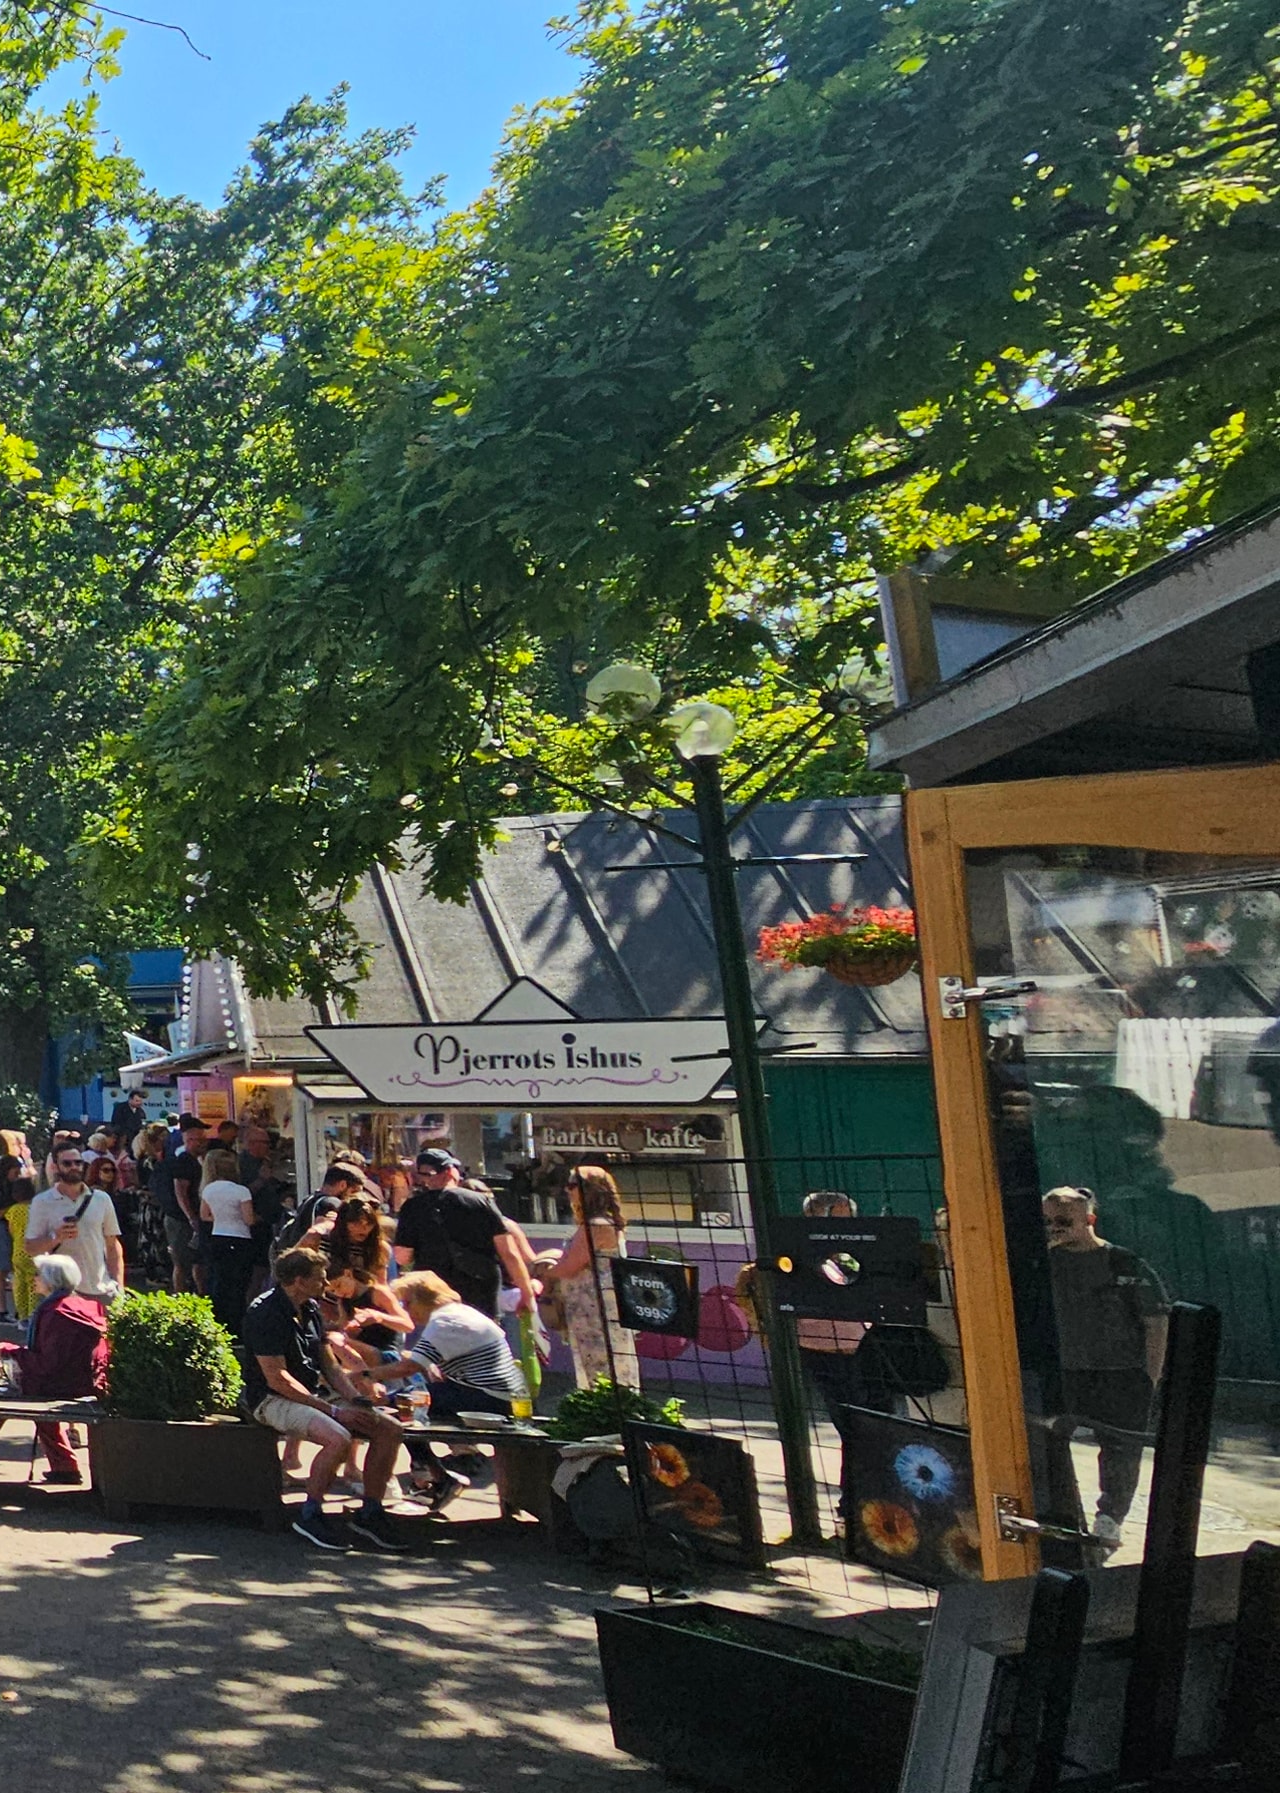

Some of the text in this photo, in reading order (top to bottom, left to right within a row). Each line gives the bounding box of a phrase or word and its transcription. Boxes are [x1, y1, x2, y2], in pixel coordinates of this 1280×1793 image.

[413, 1033, 556, 1076] Pjerrots
[542, 1126, 705, 1148] Barista kaffe
[630, 1274, 665, 1290] From
